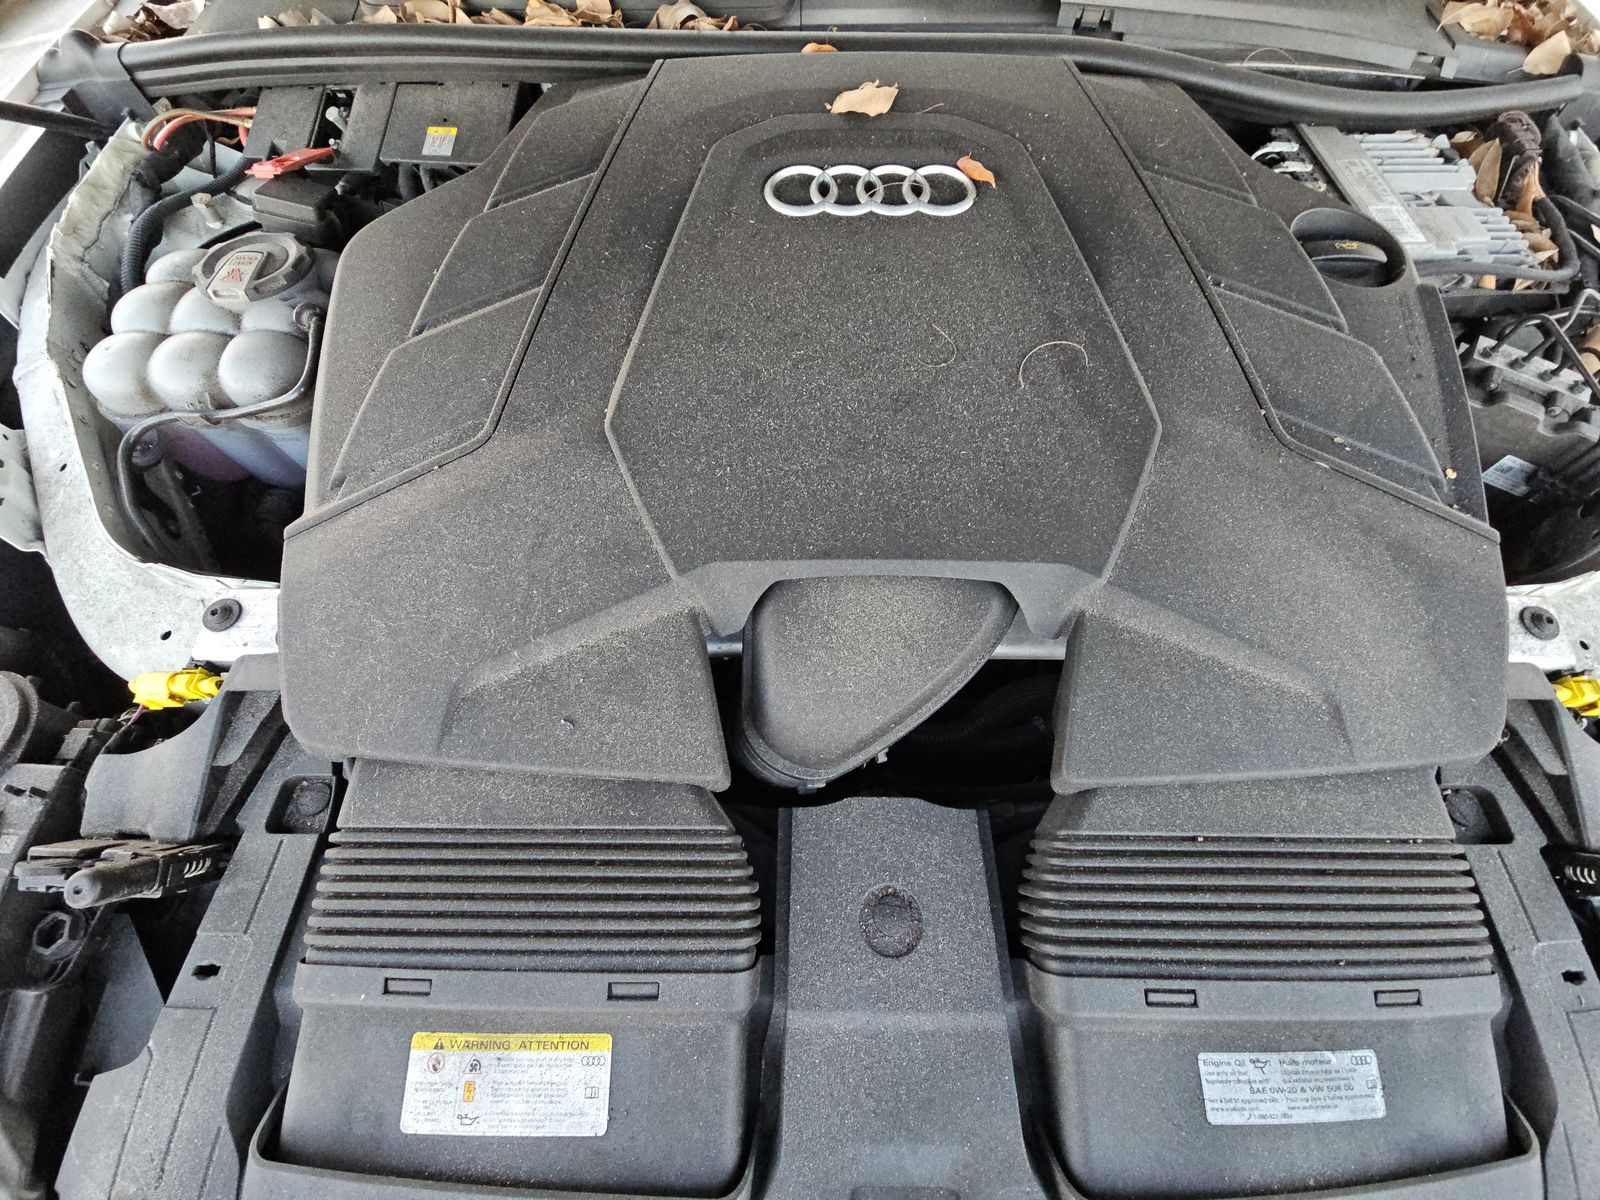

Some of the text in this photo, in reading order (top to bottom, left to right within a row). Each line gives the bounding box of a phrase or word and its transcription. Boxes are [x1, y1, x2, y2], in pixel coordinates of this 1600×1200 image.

[449, 1039, 590, 1050] WARNING ATTENTION
[1202, 1059, 1246, 1068] Engine Oil
[1302, 1058, 1331, 1066] moteur
[1249, 1086, 1267, 1095] SAE
[1269, 1086, 1298, 1094] 0W-20
[1309, 1085, 1324, 1093] VW
